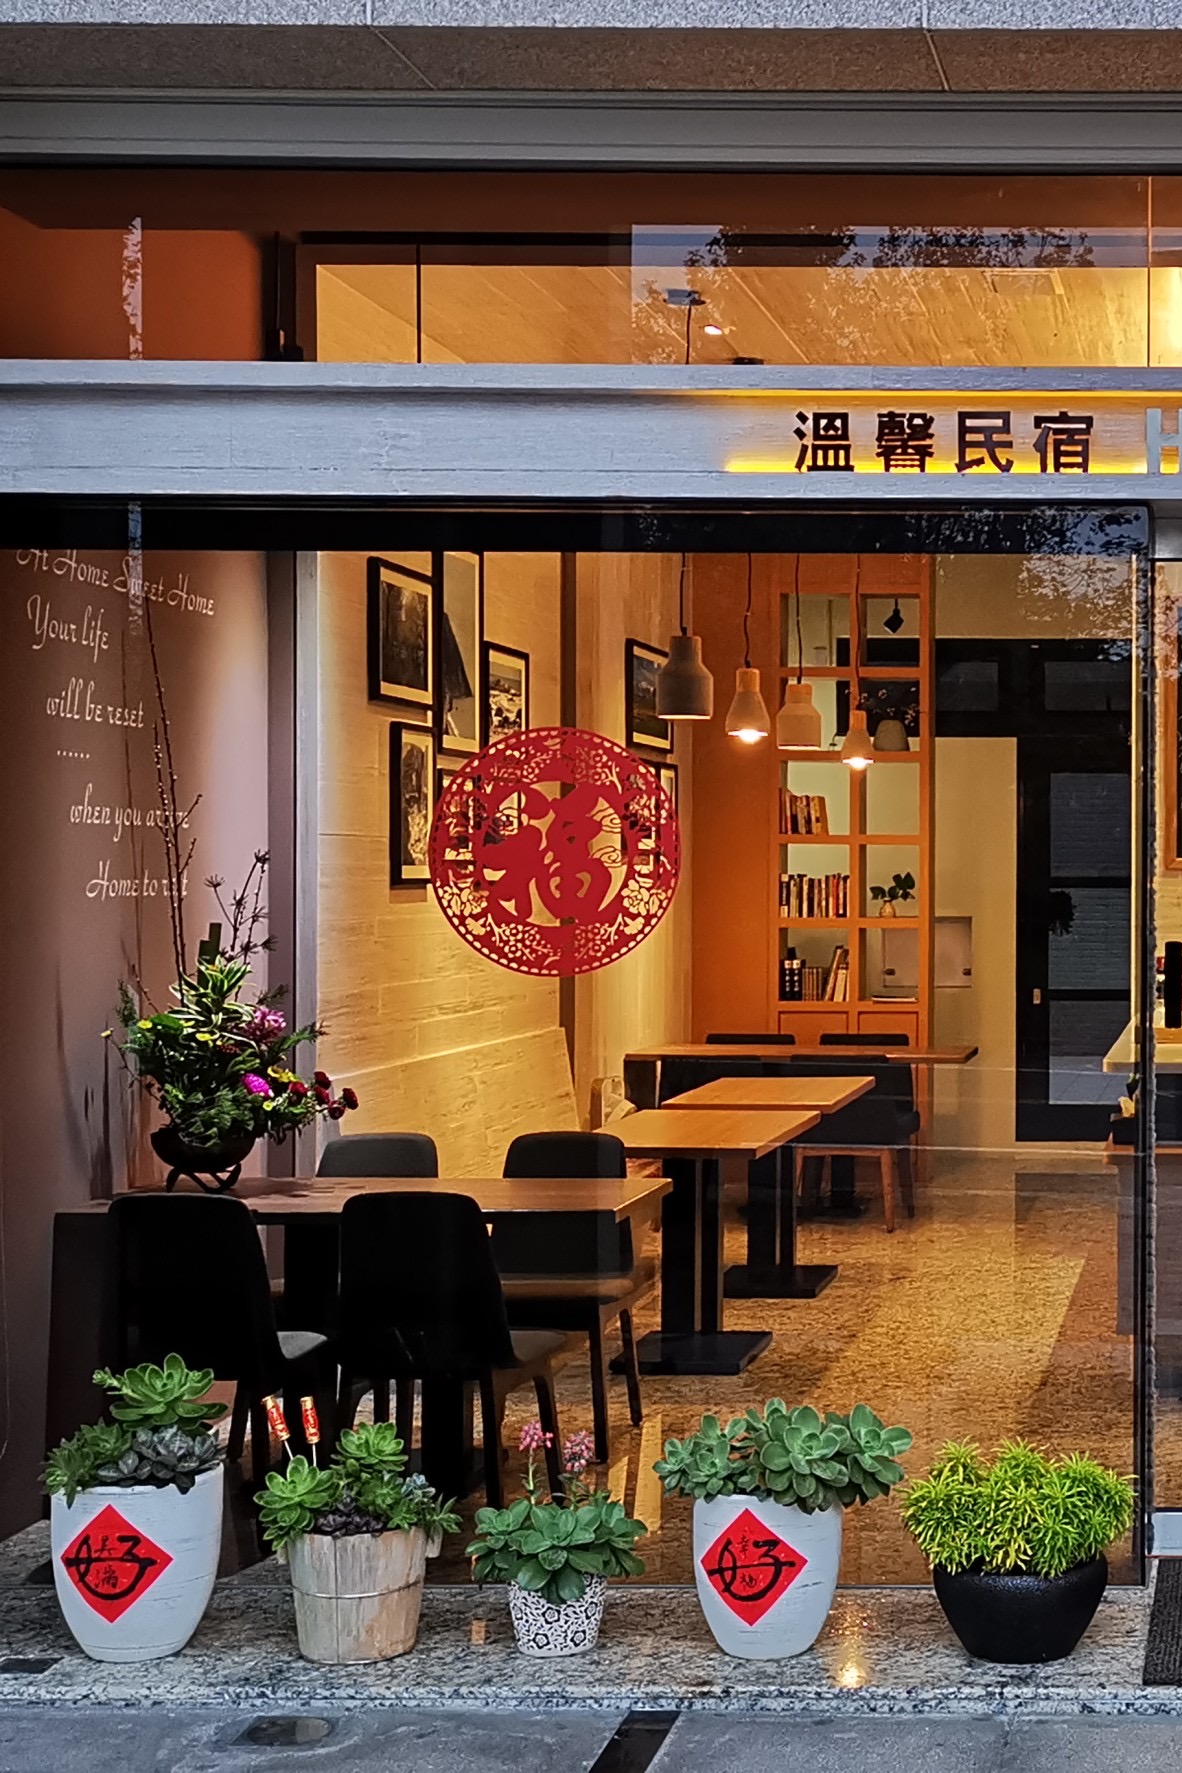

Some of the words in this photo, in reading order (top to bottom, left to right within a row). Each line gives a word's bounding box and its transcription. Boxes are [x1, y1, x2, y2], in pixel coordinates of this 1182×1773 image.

[794, 410, 1095, 474] 溫馨民宿
[53, 549, 109, 587] Home
[113, 556, 165, 602] Sweet
[167, 573, 215, 616] Home
[27, 594, 77, 650] Your
[82, 605, 109, 664] life
[46, 677, 83, 719] will
[85, 681, 103, 722] be
[107, 701, 145, 728] reset
[70, 783, 111, 824] when
[113, 808, 142, 842] you
[86, 859, 139, 900] Home
[143, 869, 158, 896] to
